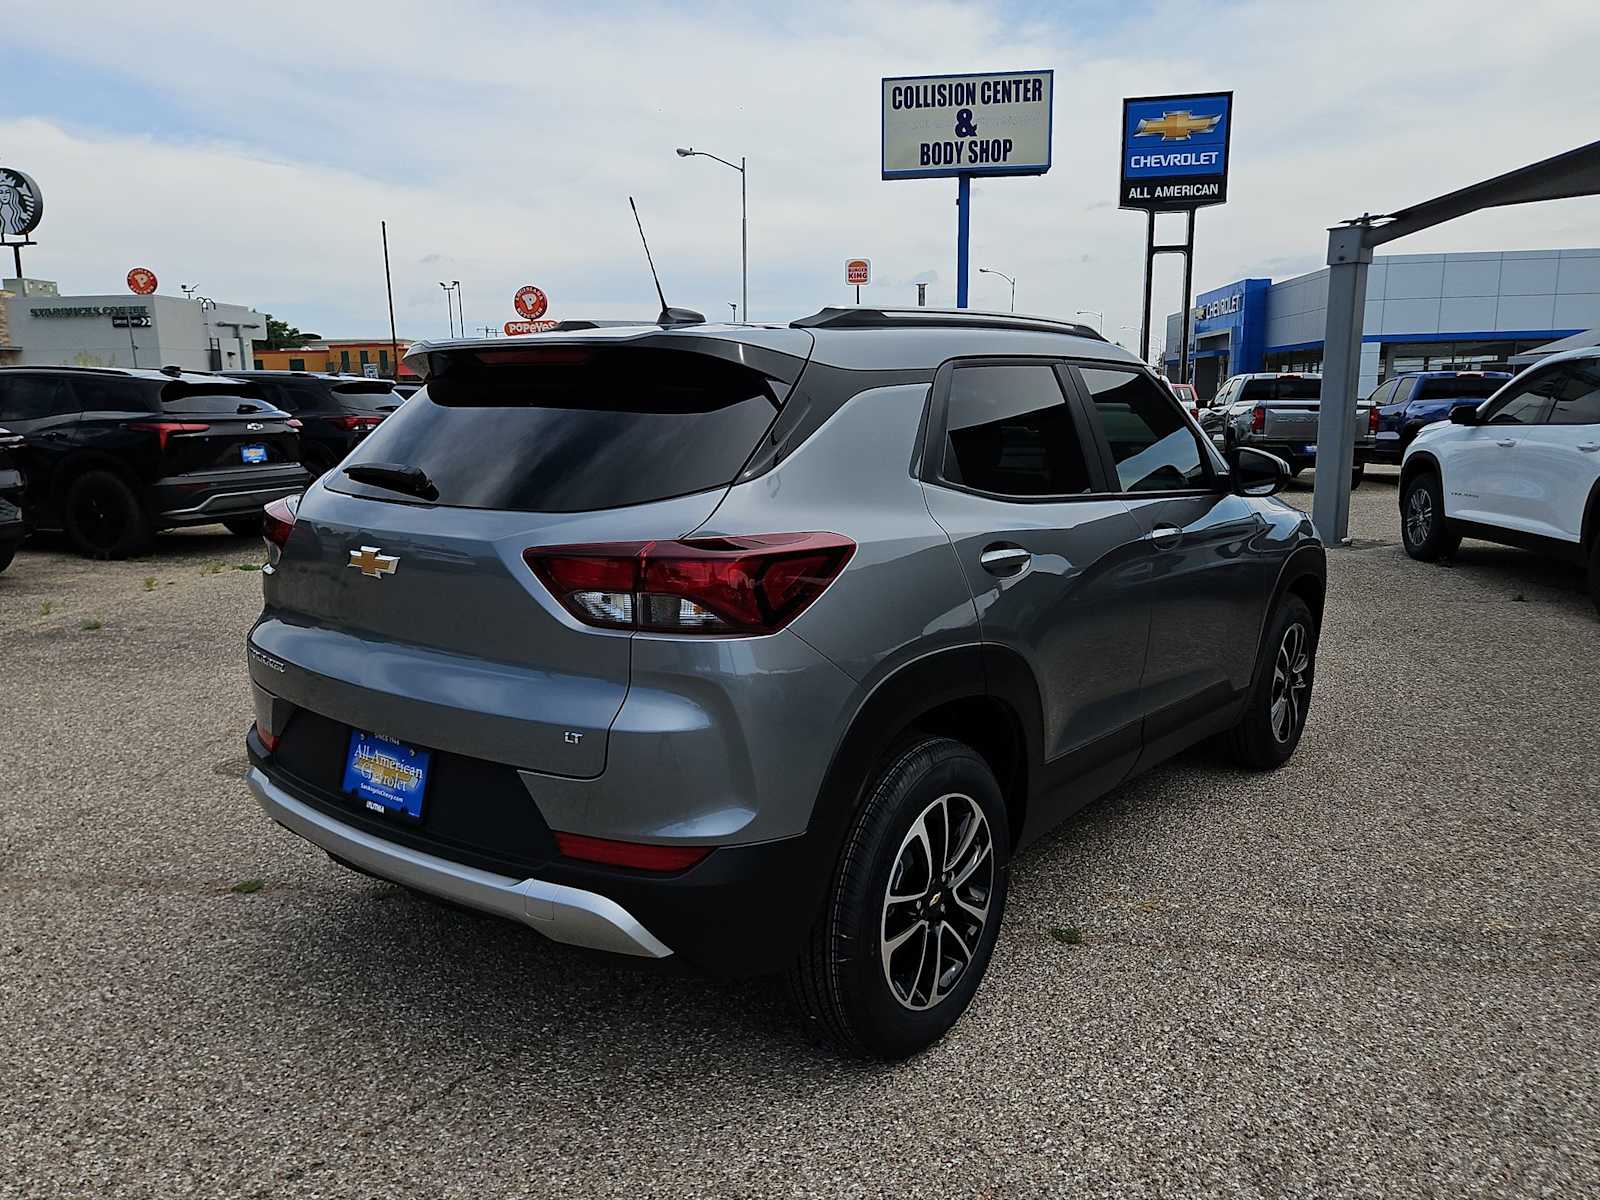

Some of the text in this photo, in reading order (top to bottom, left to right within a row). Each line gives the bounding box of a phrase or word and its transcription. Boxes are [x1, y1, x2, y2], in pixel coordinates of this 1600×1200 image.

[892, 78, 1043, 110] COLLISION CENTER
[955, 108, 977, 138] &
[920, 138, 1013, 166] BODY SHOP
[1130, 151, 1219, 168] CHEVROLET
[1128, 183, 1219, 199] ALL AMERICAN
[1206, 294, 1243, 319] CHEVROLET
[564, 731, 583, 744] LT
[354, 743, 423, 779] All American
